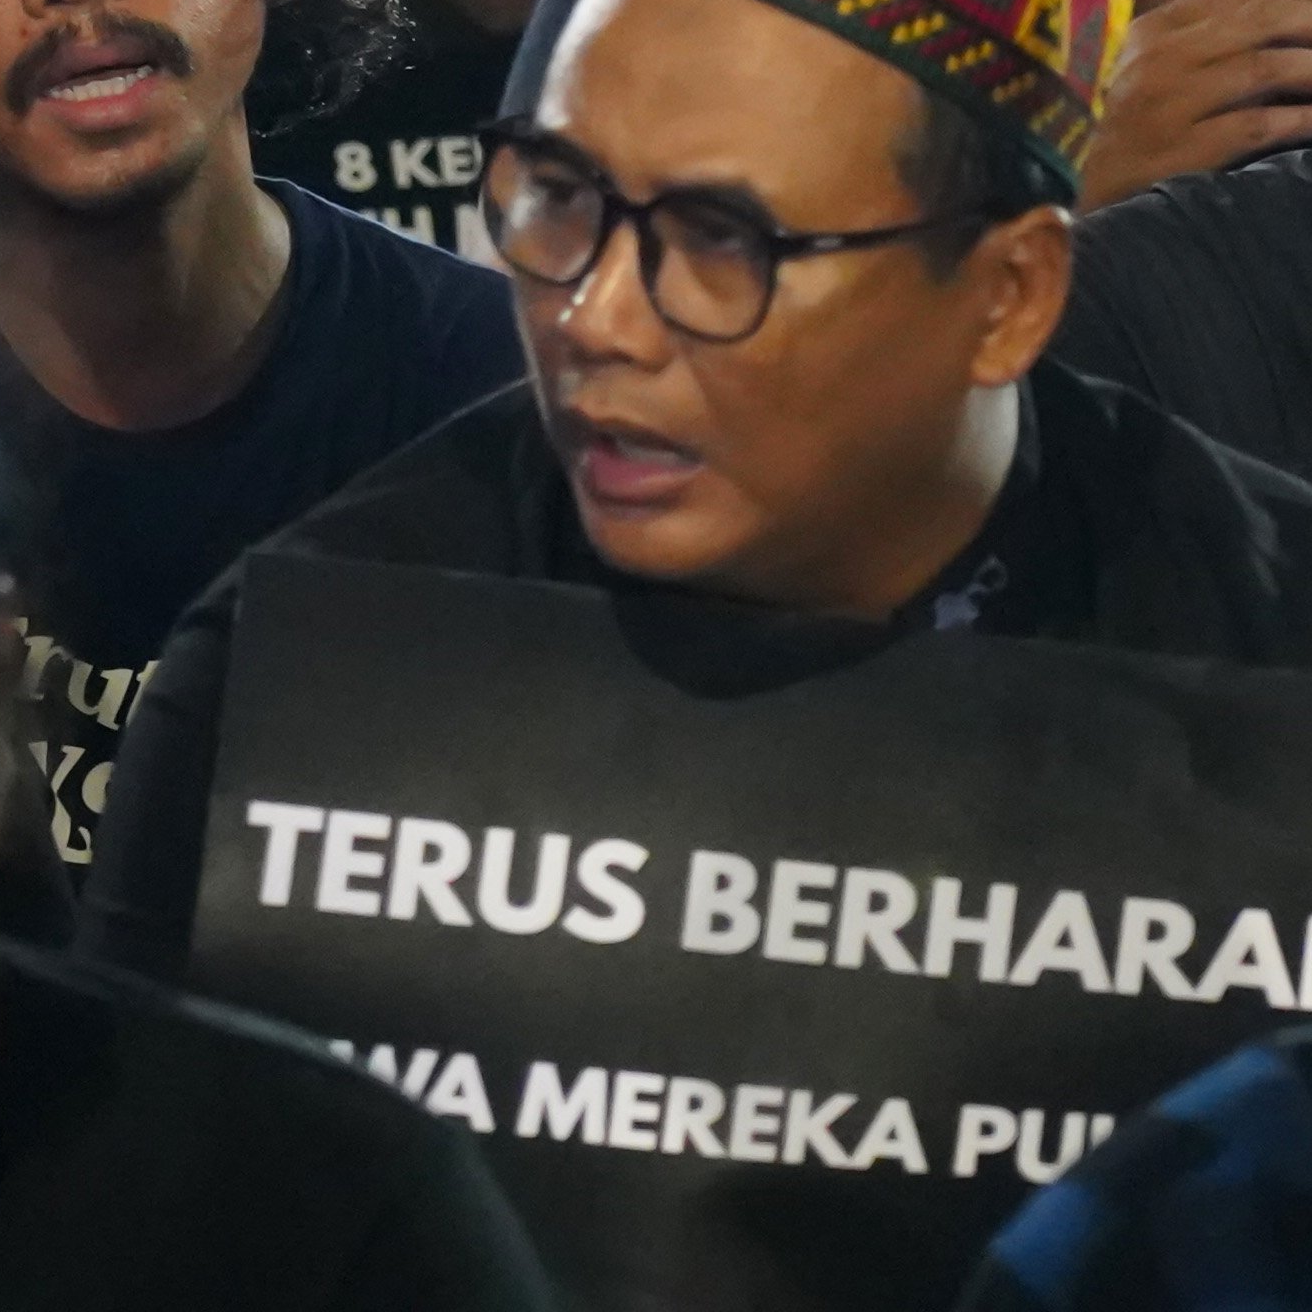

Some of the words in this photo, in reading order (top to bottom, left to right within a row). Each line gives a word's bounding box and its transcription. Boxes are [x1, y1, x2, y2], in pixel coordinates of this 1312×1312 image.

[332, 140, 379, 193] 8
[389, 135, 485, 191] KE
[246, 800, 650, 944] TERUS
[516, 1061, 928, 1176] MEREKA
